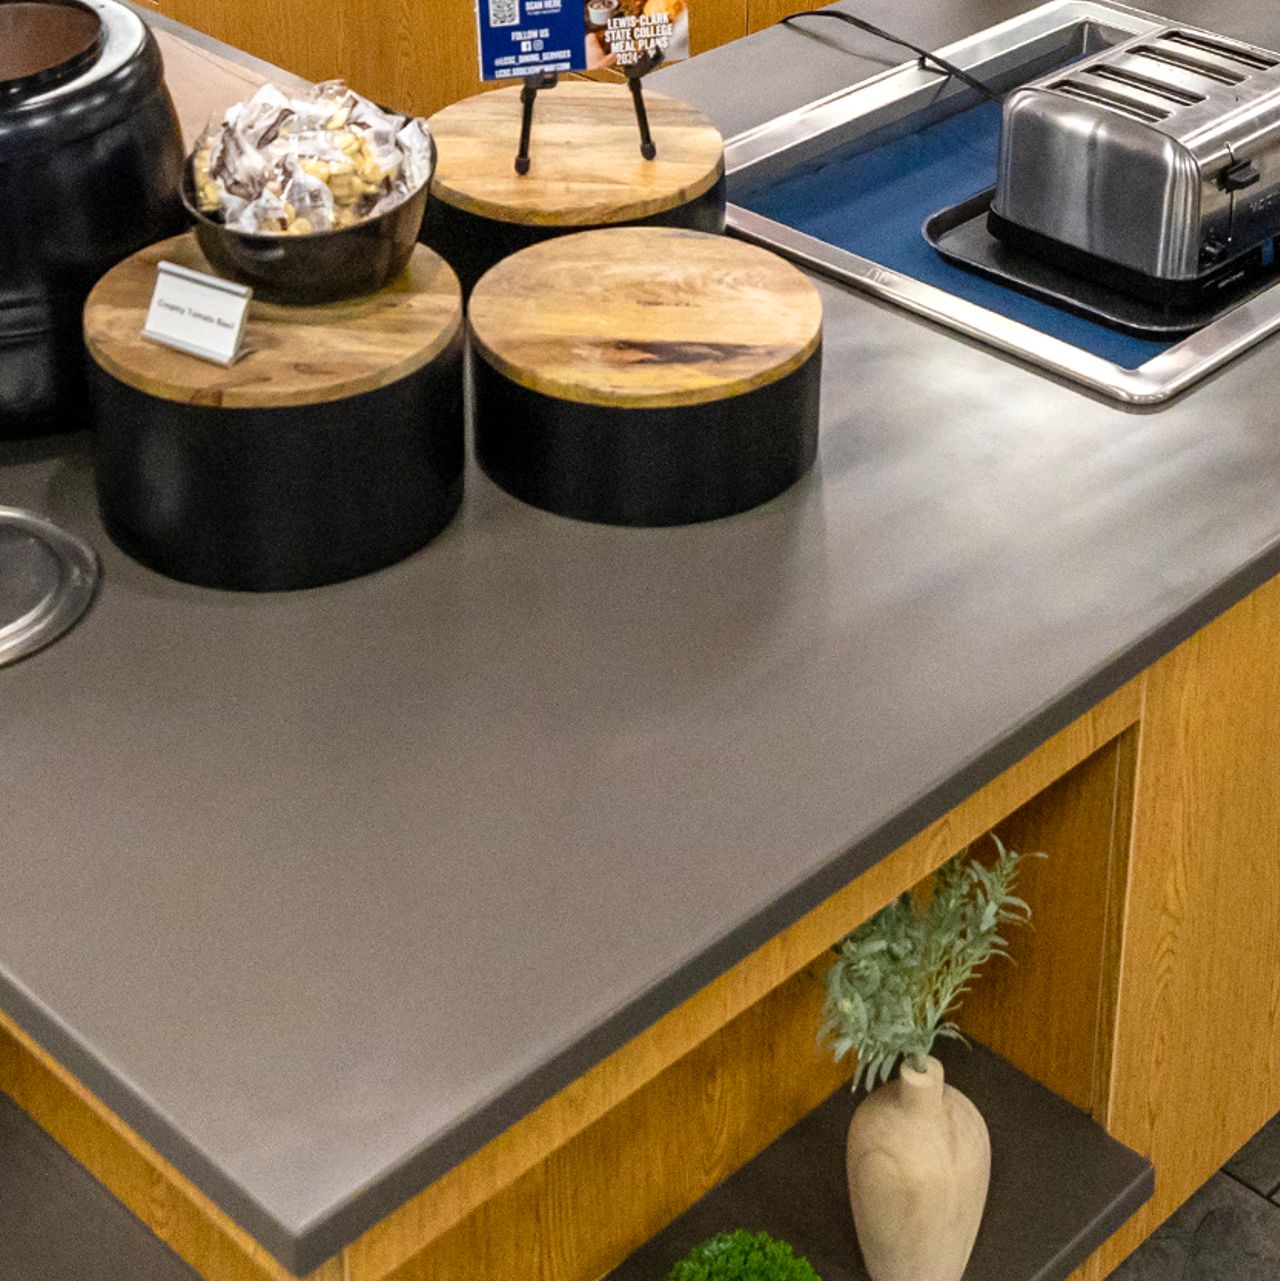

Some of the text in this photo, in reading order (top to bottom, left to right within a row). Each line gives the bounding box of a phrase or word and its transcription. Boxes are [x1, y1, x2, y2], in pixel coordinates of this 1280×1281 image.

[607, 12, 669, 30] LEWIS-CLARK
[604, 24, 673, 43] STATE COLLEGE
[611, 36, 669, 54] MEAL PLANS
